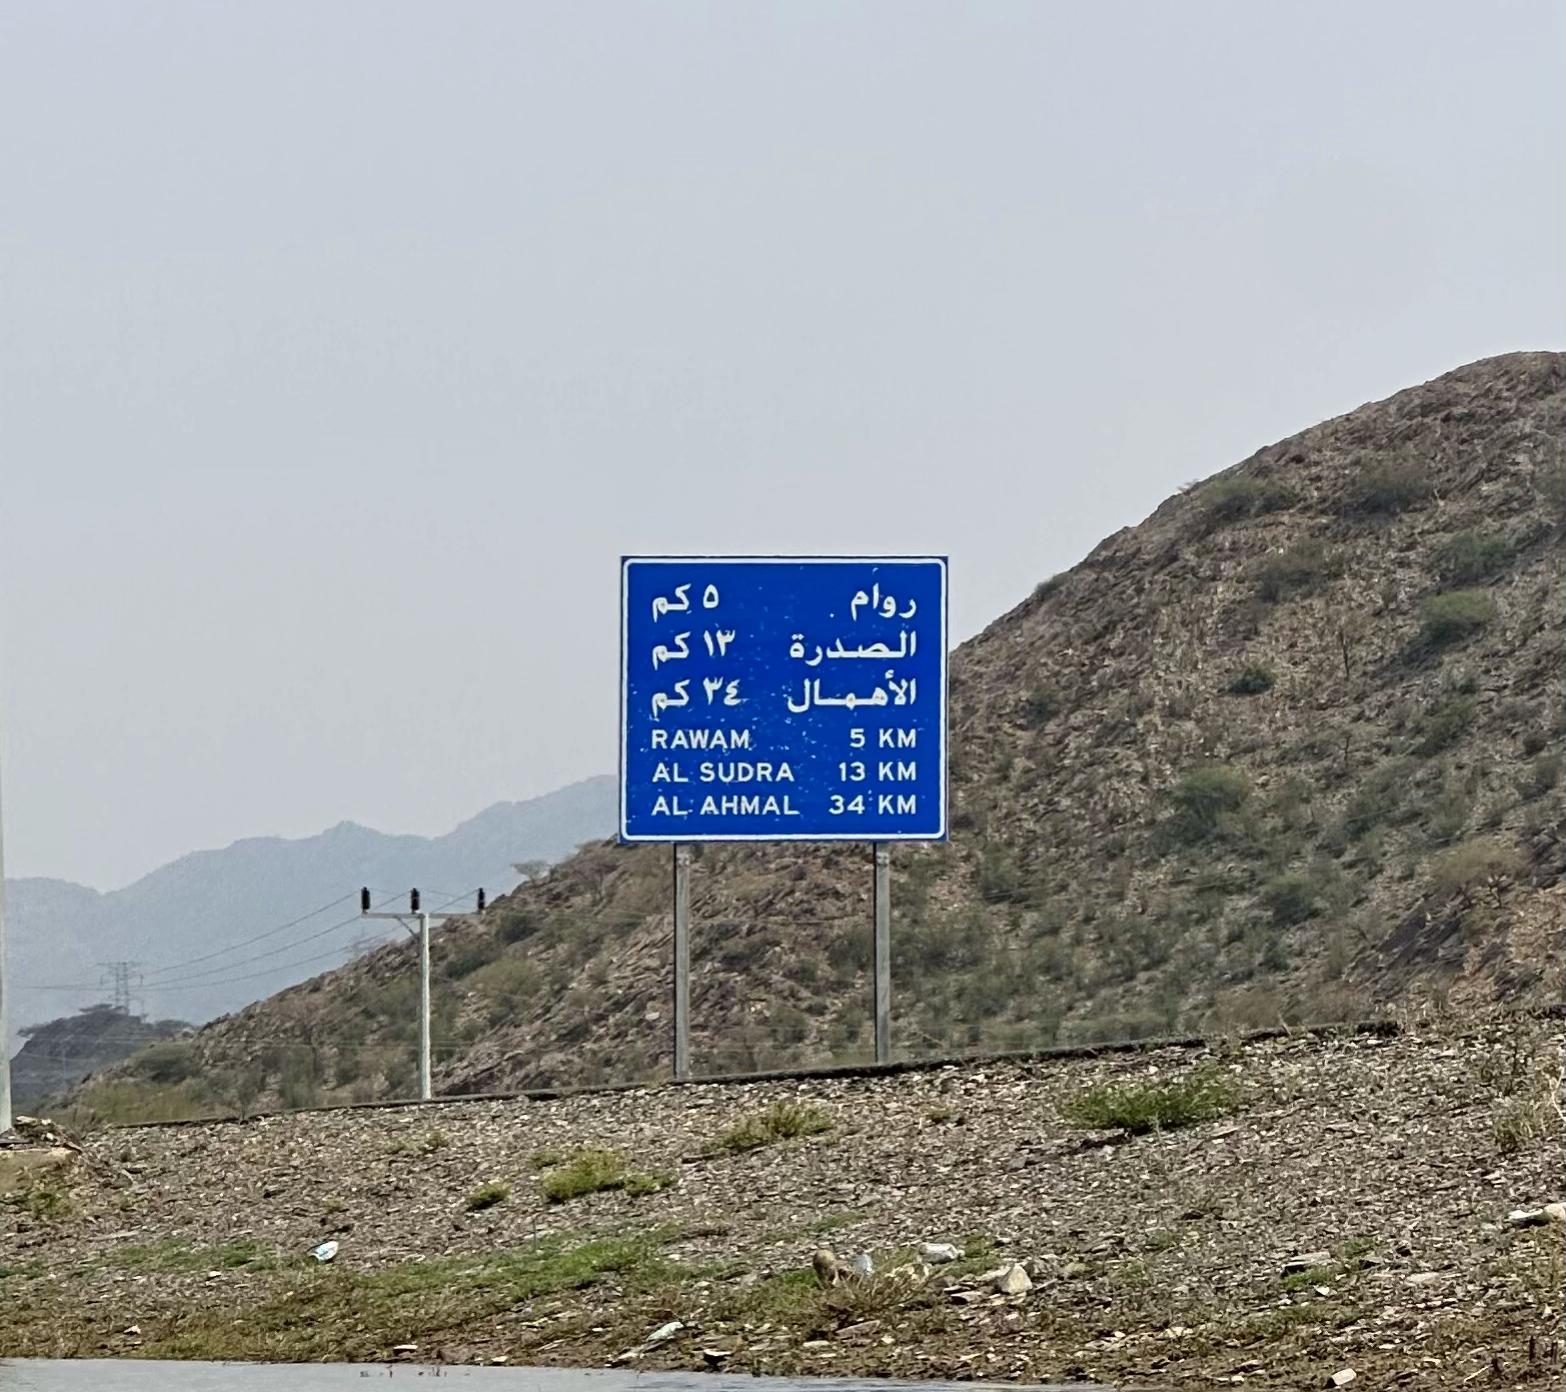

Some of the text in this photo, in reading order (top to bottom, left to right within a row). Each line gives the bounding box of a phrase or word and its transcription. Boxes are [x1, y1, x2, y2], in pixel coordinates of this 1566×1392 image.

[652, 583, 917, 622] روام ٥ كم
[652, 630, 917, 670] الصدرة ١٣ كم
[651, 669, 916, 718] الأهمال ٣٤ كم
[651, 728, 916, 749] RAWAM 5 KM
[652, 761, 916, 783] AL SUDRA 13 KM
[651, 794, 916, 816] AL AHMAL 34 KM
